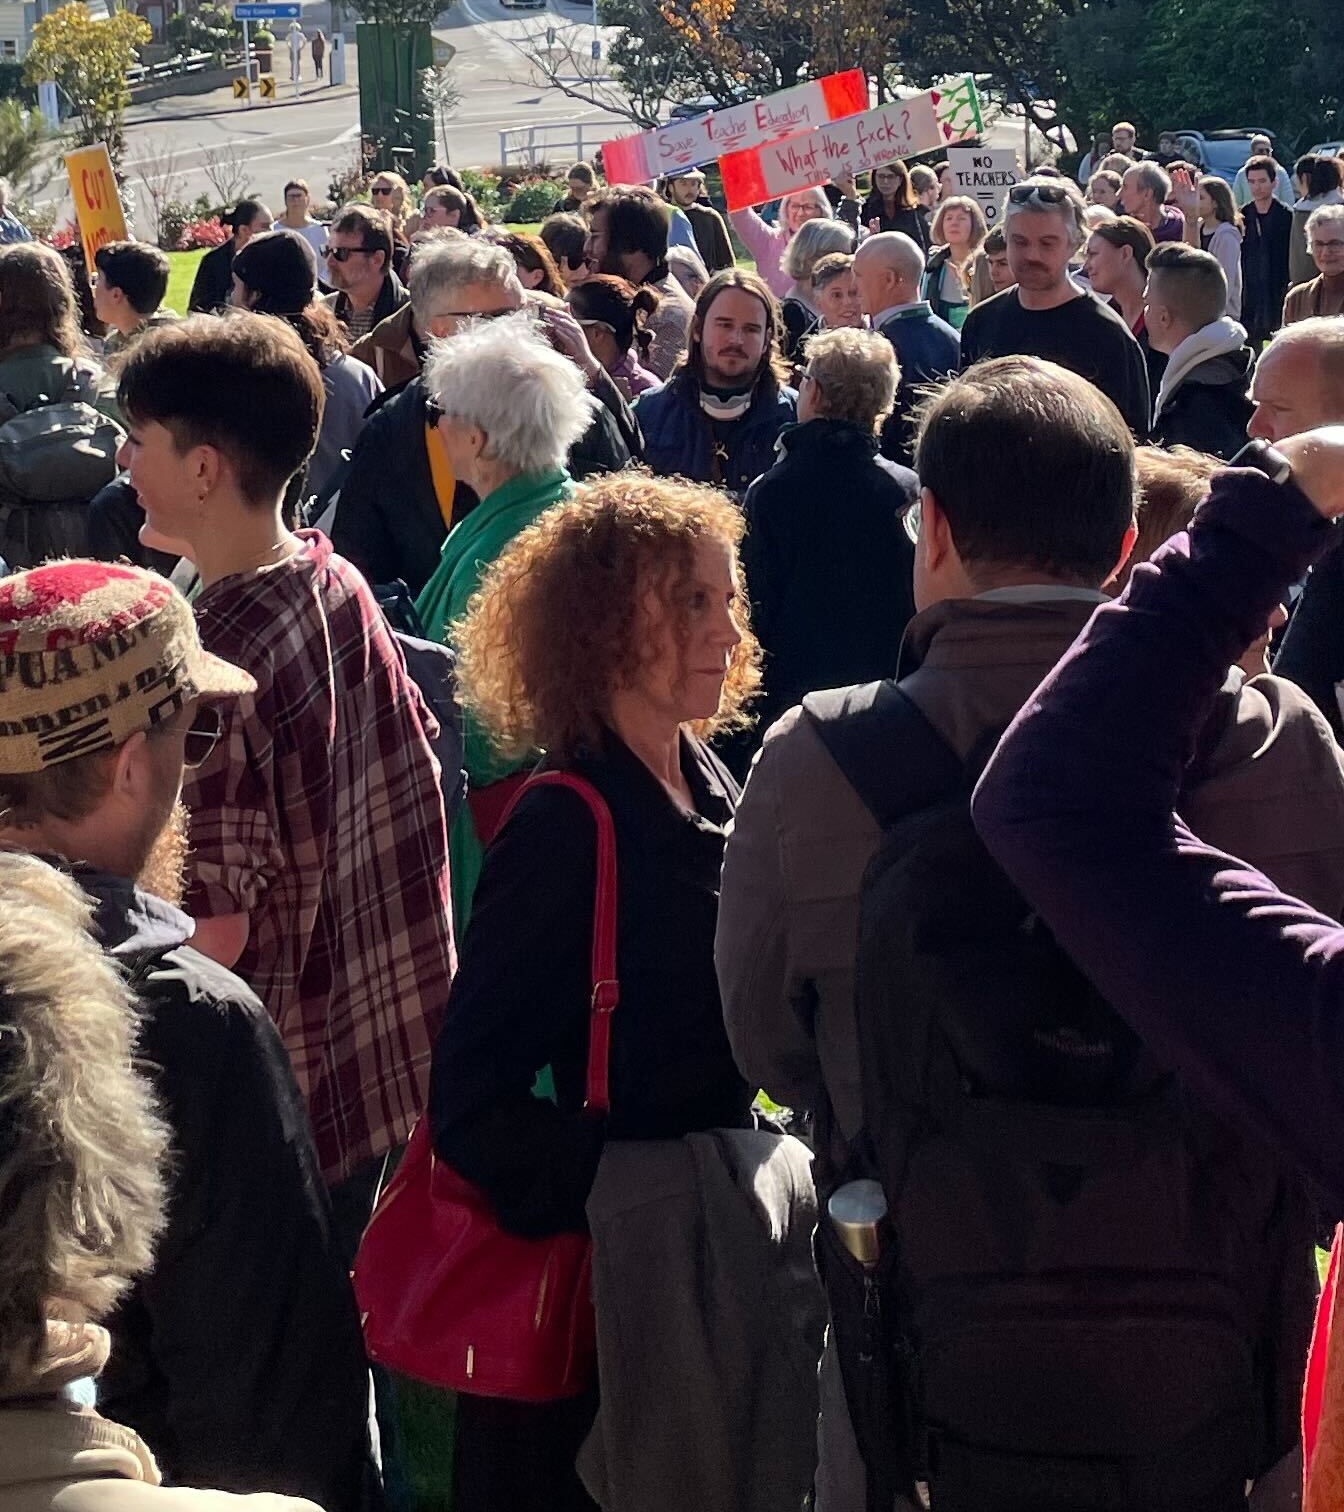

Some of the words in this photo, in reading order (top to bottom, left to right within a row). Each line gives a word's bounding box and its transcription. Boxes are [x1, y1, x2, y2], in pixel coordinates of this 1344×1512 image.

[658, 134, 698, 158] Save
[701, 117, 747, 141] Teacher
[754, 103, 810, 130] Education
[775, 139, 821, 176] What
[822, 135, 850, 160] the
[803, 167, 832, 186] THIS
[873, 145, 910, 163] WRONG
[972, 155, 993, 169] NO
[81, 167, 111, 211] CUT
[955, 170, 1017, 186] TEACHERS
